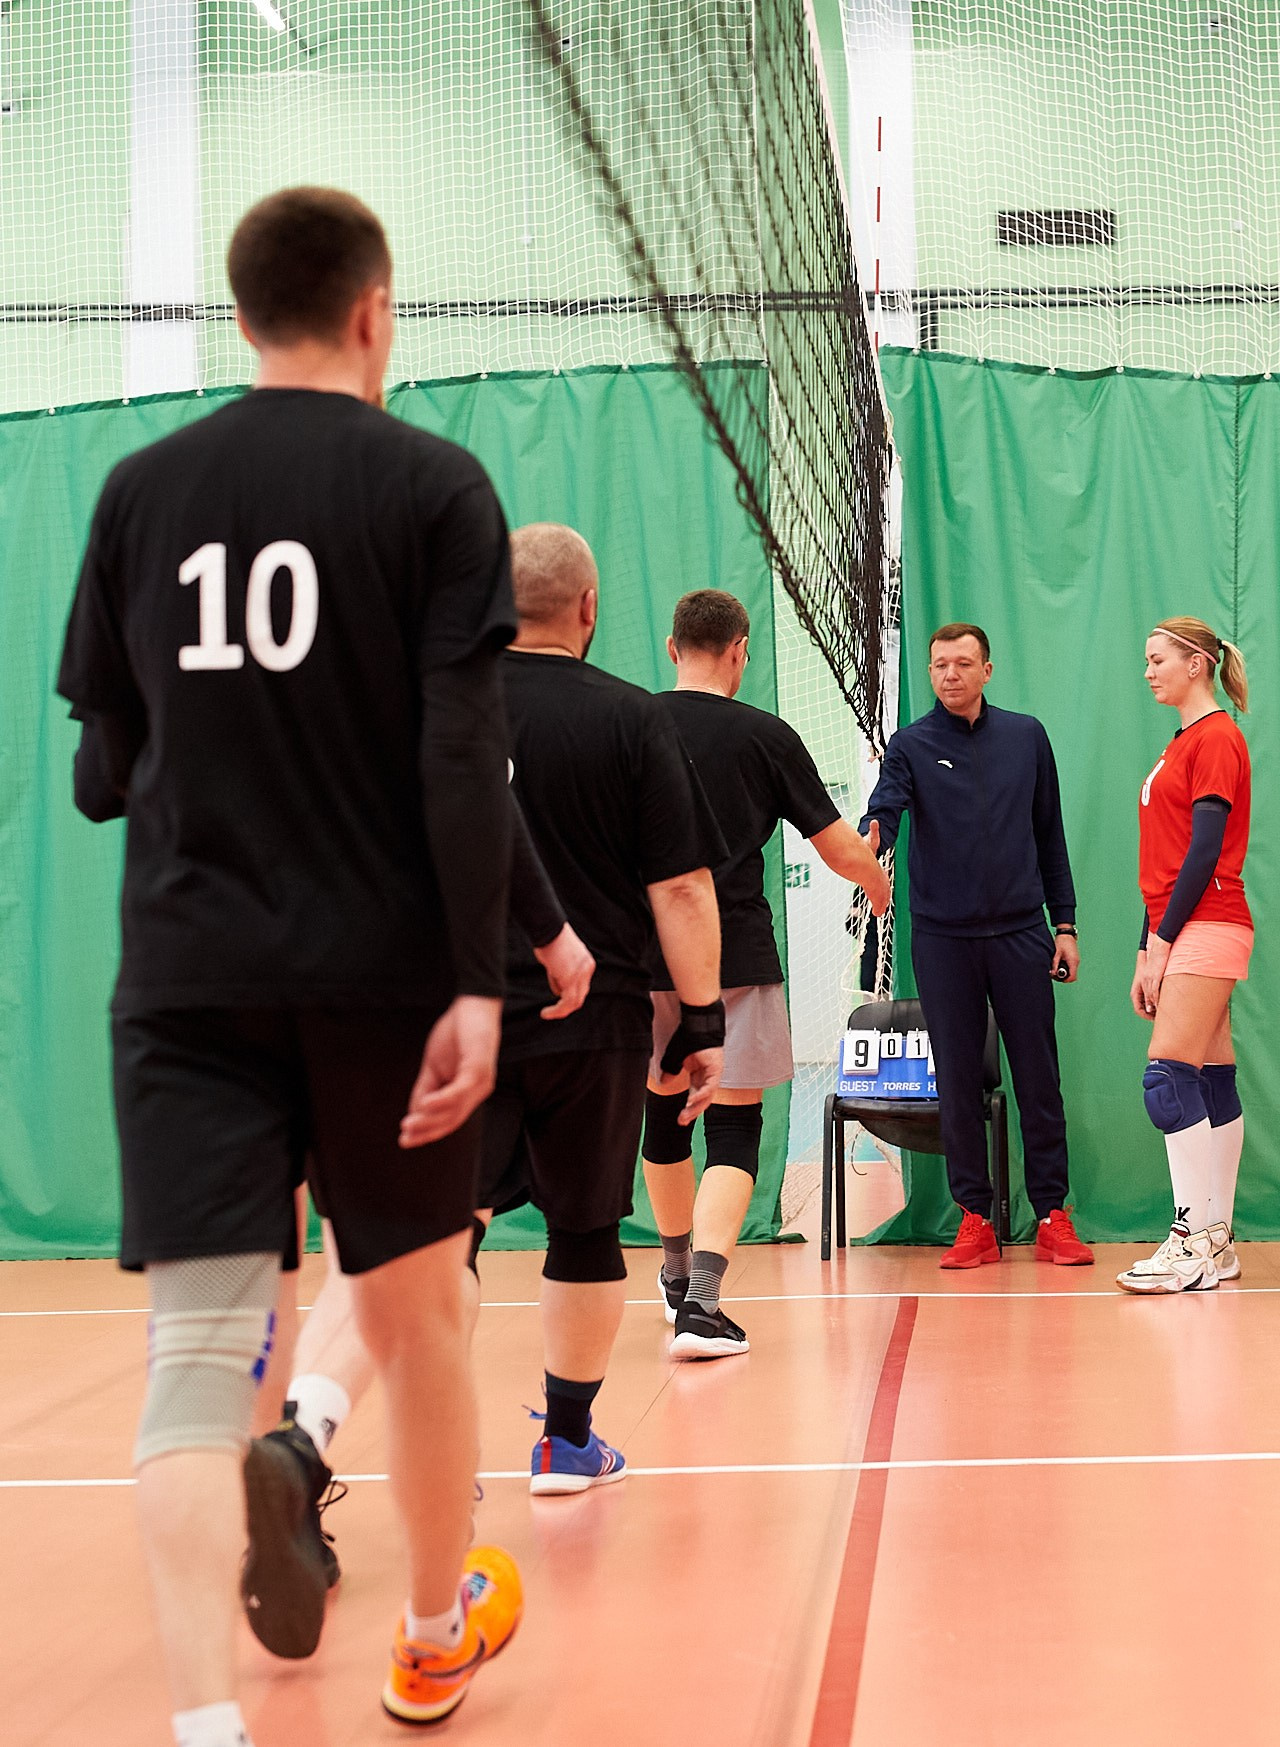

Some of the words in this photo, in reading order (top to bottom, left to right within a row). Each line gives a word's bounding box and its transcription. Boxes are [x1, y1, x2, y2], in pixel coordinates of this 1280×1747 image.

[178, 539, 319, 672] 10
[854, 1039, 869, 1067] 9
[887, 1038, 896, 1056] 0
[914, 1037, 921, 1056] 1
[840, 1080, 877, 1092] GUEST
[882, 1081, 922, 1091] TORRES
